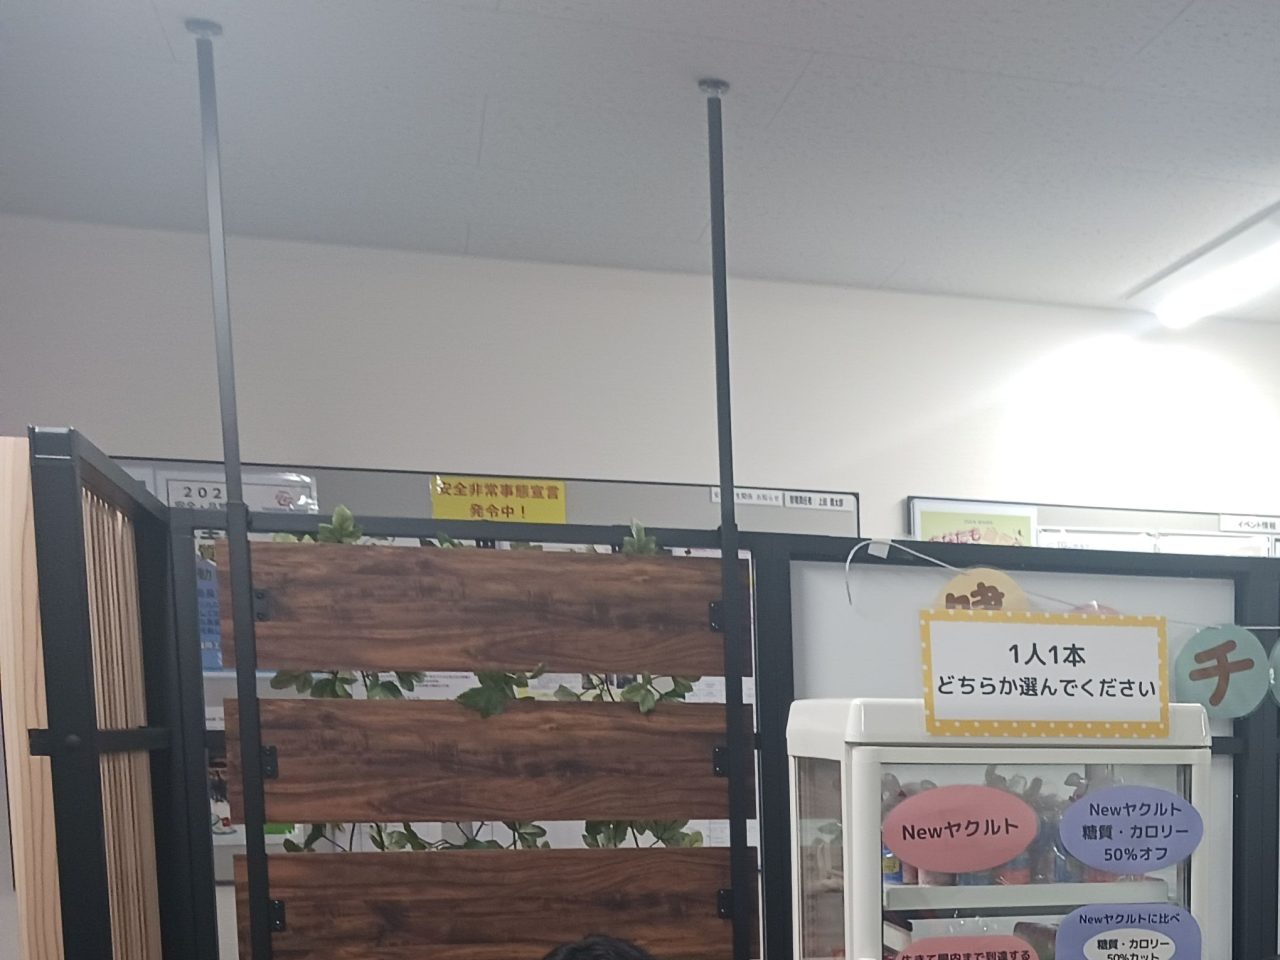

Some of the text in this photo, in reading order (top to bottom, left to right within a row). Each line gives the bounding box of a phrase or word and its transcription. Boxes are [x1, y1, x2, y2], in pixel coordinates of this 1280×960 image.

[184, 486, 222, 499] 202
[1009, 642, 1086, 667] 1人1本
[937, 675, 1157, 699] どちらか選んでください
[1089, 802, 1182, 818] Newヤクルト
[902, 817, 1019, 841] Newヤクルト
[1082, 824, 1189, 841] 糖質・カロリー
[1104, 847, 1169, 862] 50%オフ
[1079, 913, 1181, 925] Newヤクルトに比べ
